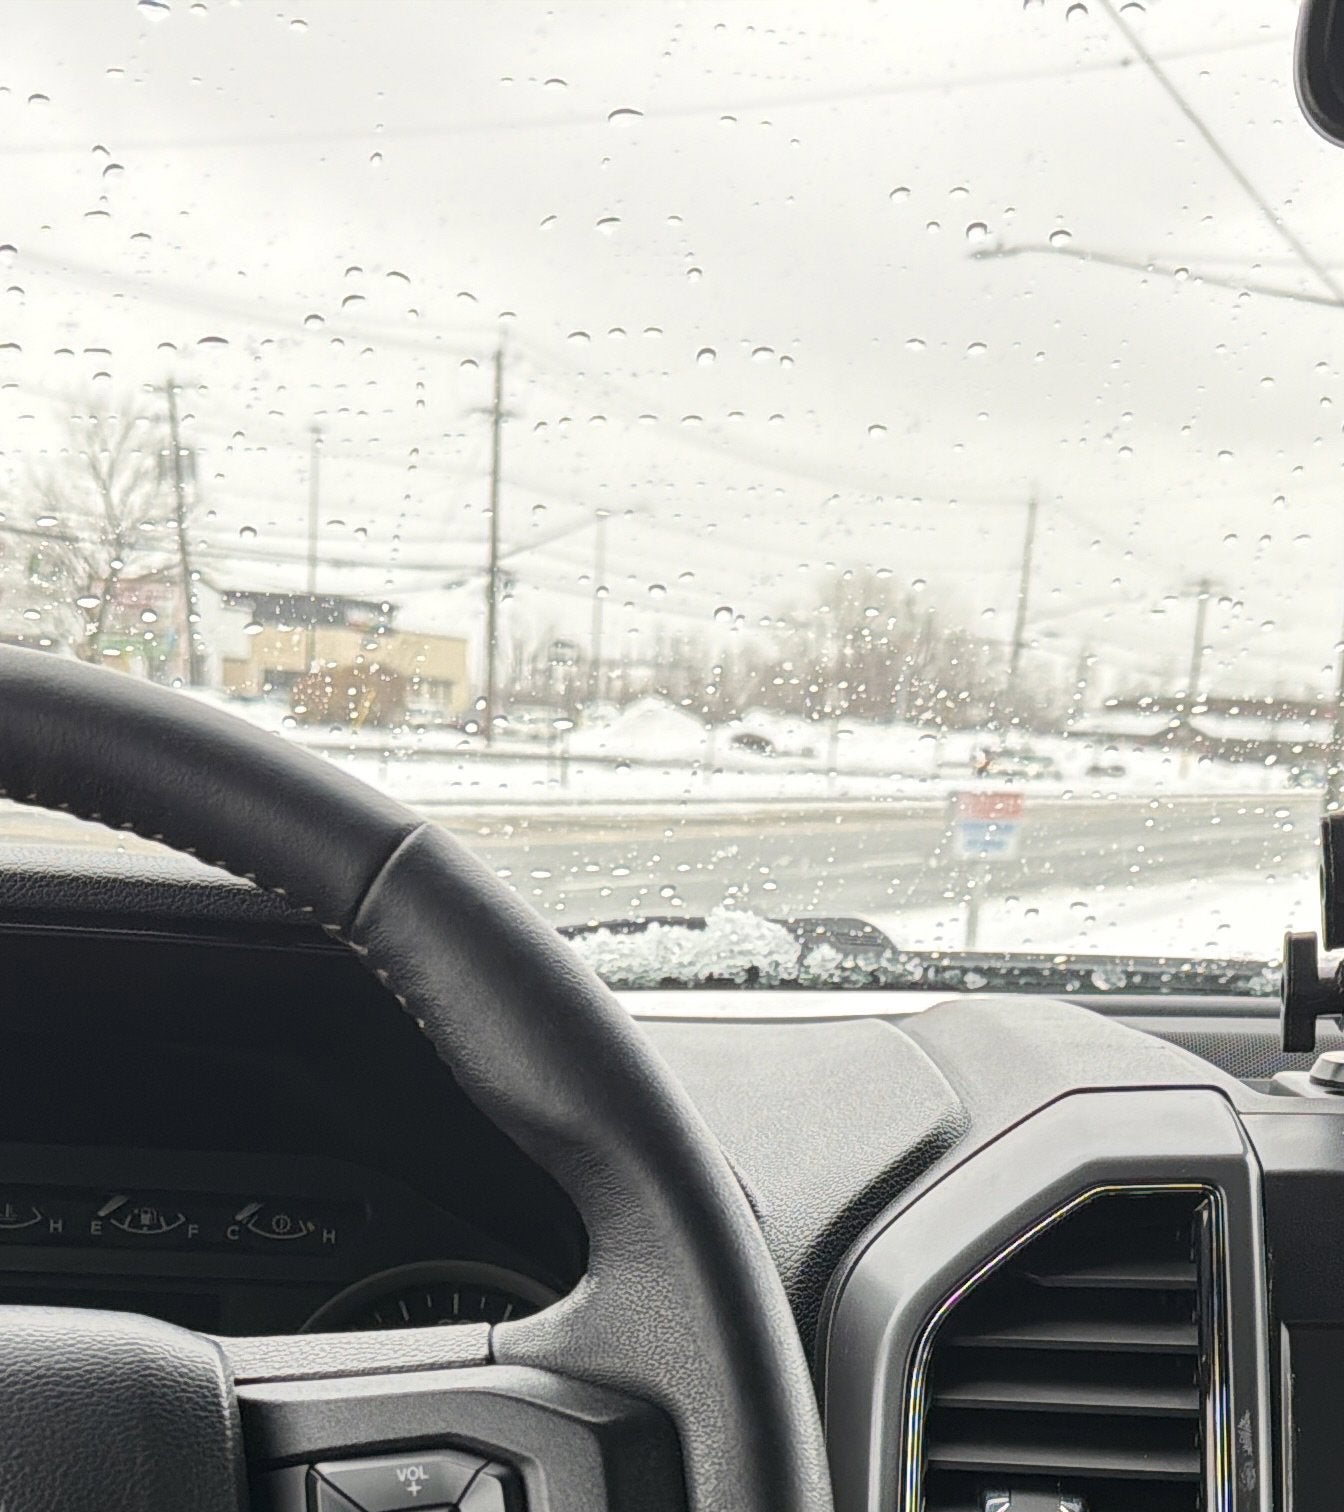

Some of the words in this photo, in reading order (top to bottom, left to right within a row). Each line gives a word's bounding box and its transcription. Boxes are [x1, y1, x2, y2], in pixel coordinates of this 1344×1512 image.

[49, 1218, 63, 1234] H
[90, 1220, 102, 1236] E
[187, 1224, 200, 1239] F
[226, 1225, 240, 1241] C
[322, 1229, 336, 1245] H
[396, 1465, 430, 1482] VOL
